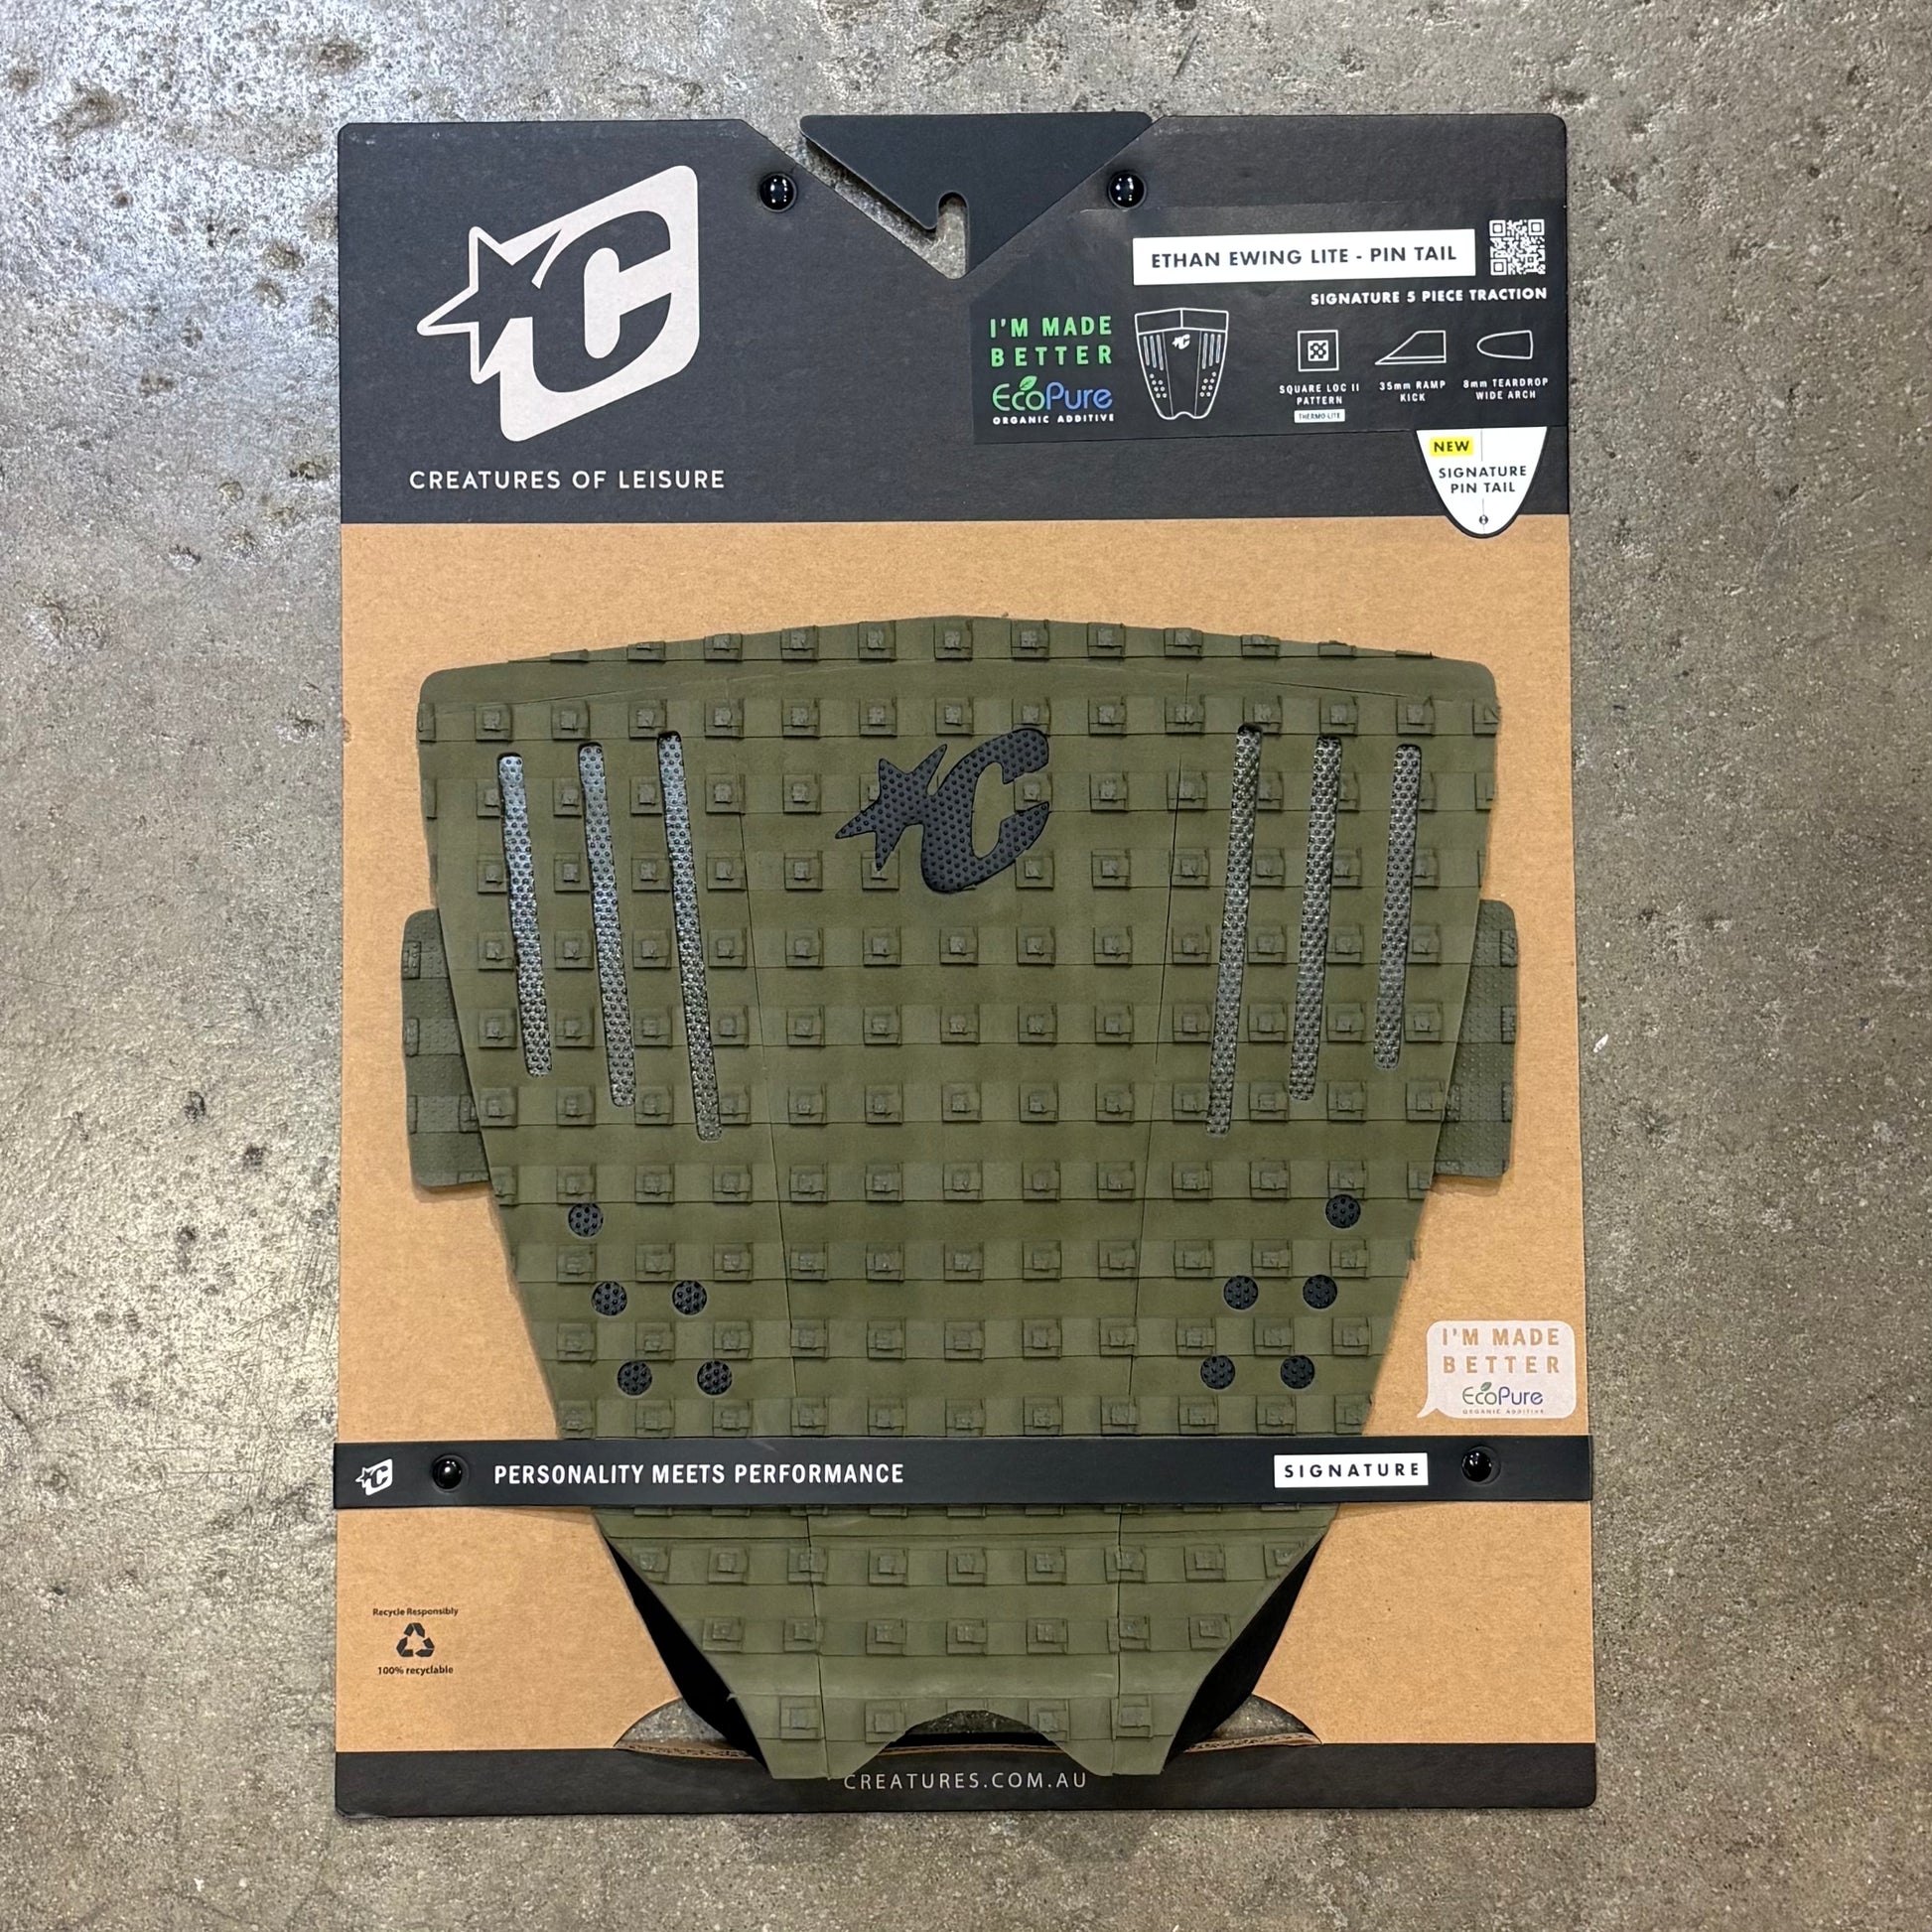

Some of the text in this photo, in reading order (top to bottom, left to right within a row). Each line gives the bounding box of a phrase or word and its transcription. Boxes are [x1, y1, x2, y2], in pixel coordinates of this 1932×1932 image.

[1152, 252, 1220, 268] ETHAN
[1229, 250, 1303, 266] EWING
[1311, 248, 1348, 264] LITE
[1370, 247, 1406, 262] PIN
[1414, 246, 1457, 261] TAIL
[1311, 288, 1547, 306] SIGNATURE 5 PIECE TRACTION
[990, 316, 1112, 338] I'M MADE
[991, 345, 1112, 367] BETTER
[1279, 383, 1321, 395] SQUARE
[1326, 383, 1346, 392] LOC
[1379, 380, 1446, 390] 35mm RAMP
[1463, 377, 1549, 388] 8mm TEARDROP
[992, 381, 1112, 411] EcoPure
[1297, 396, 1342, 405] PATTERN
[1400, 393, 1426, 402] KICK
[1475, 390, 1536, 400] WIDE ARCH
[993, 413, 1114, 425] ORGANIC ADDITIVE
[1434, 441, 1469, 452] NEW
[409, 470, 725, 489] CREATURES OF LEISURE
[1439, 466, 1526, 479] SIGNATURE
[1450, 482, 1515, 493] PIN TAIL
[1443, 1328, 1559, 1346] I'M MADE
[1444, 1356, 1560, 1373] BETTER
[1462, 1386, 1543, 1405] EcoPure
[493, 1463, 904, 1484] PERSONALITY MEETS PERFORMANCE
[1285, 1462, 1419, 1478] SIGNATURE
[372, 1607, 459, 1617] Recycle Responsibly
[406, 1665, 454, 1676] recyclable
[844, 1771, 1087, 1790] CREATURES.COM.AU
